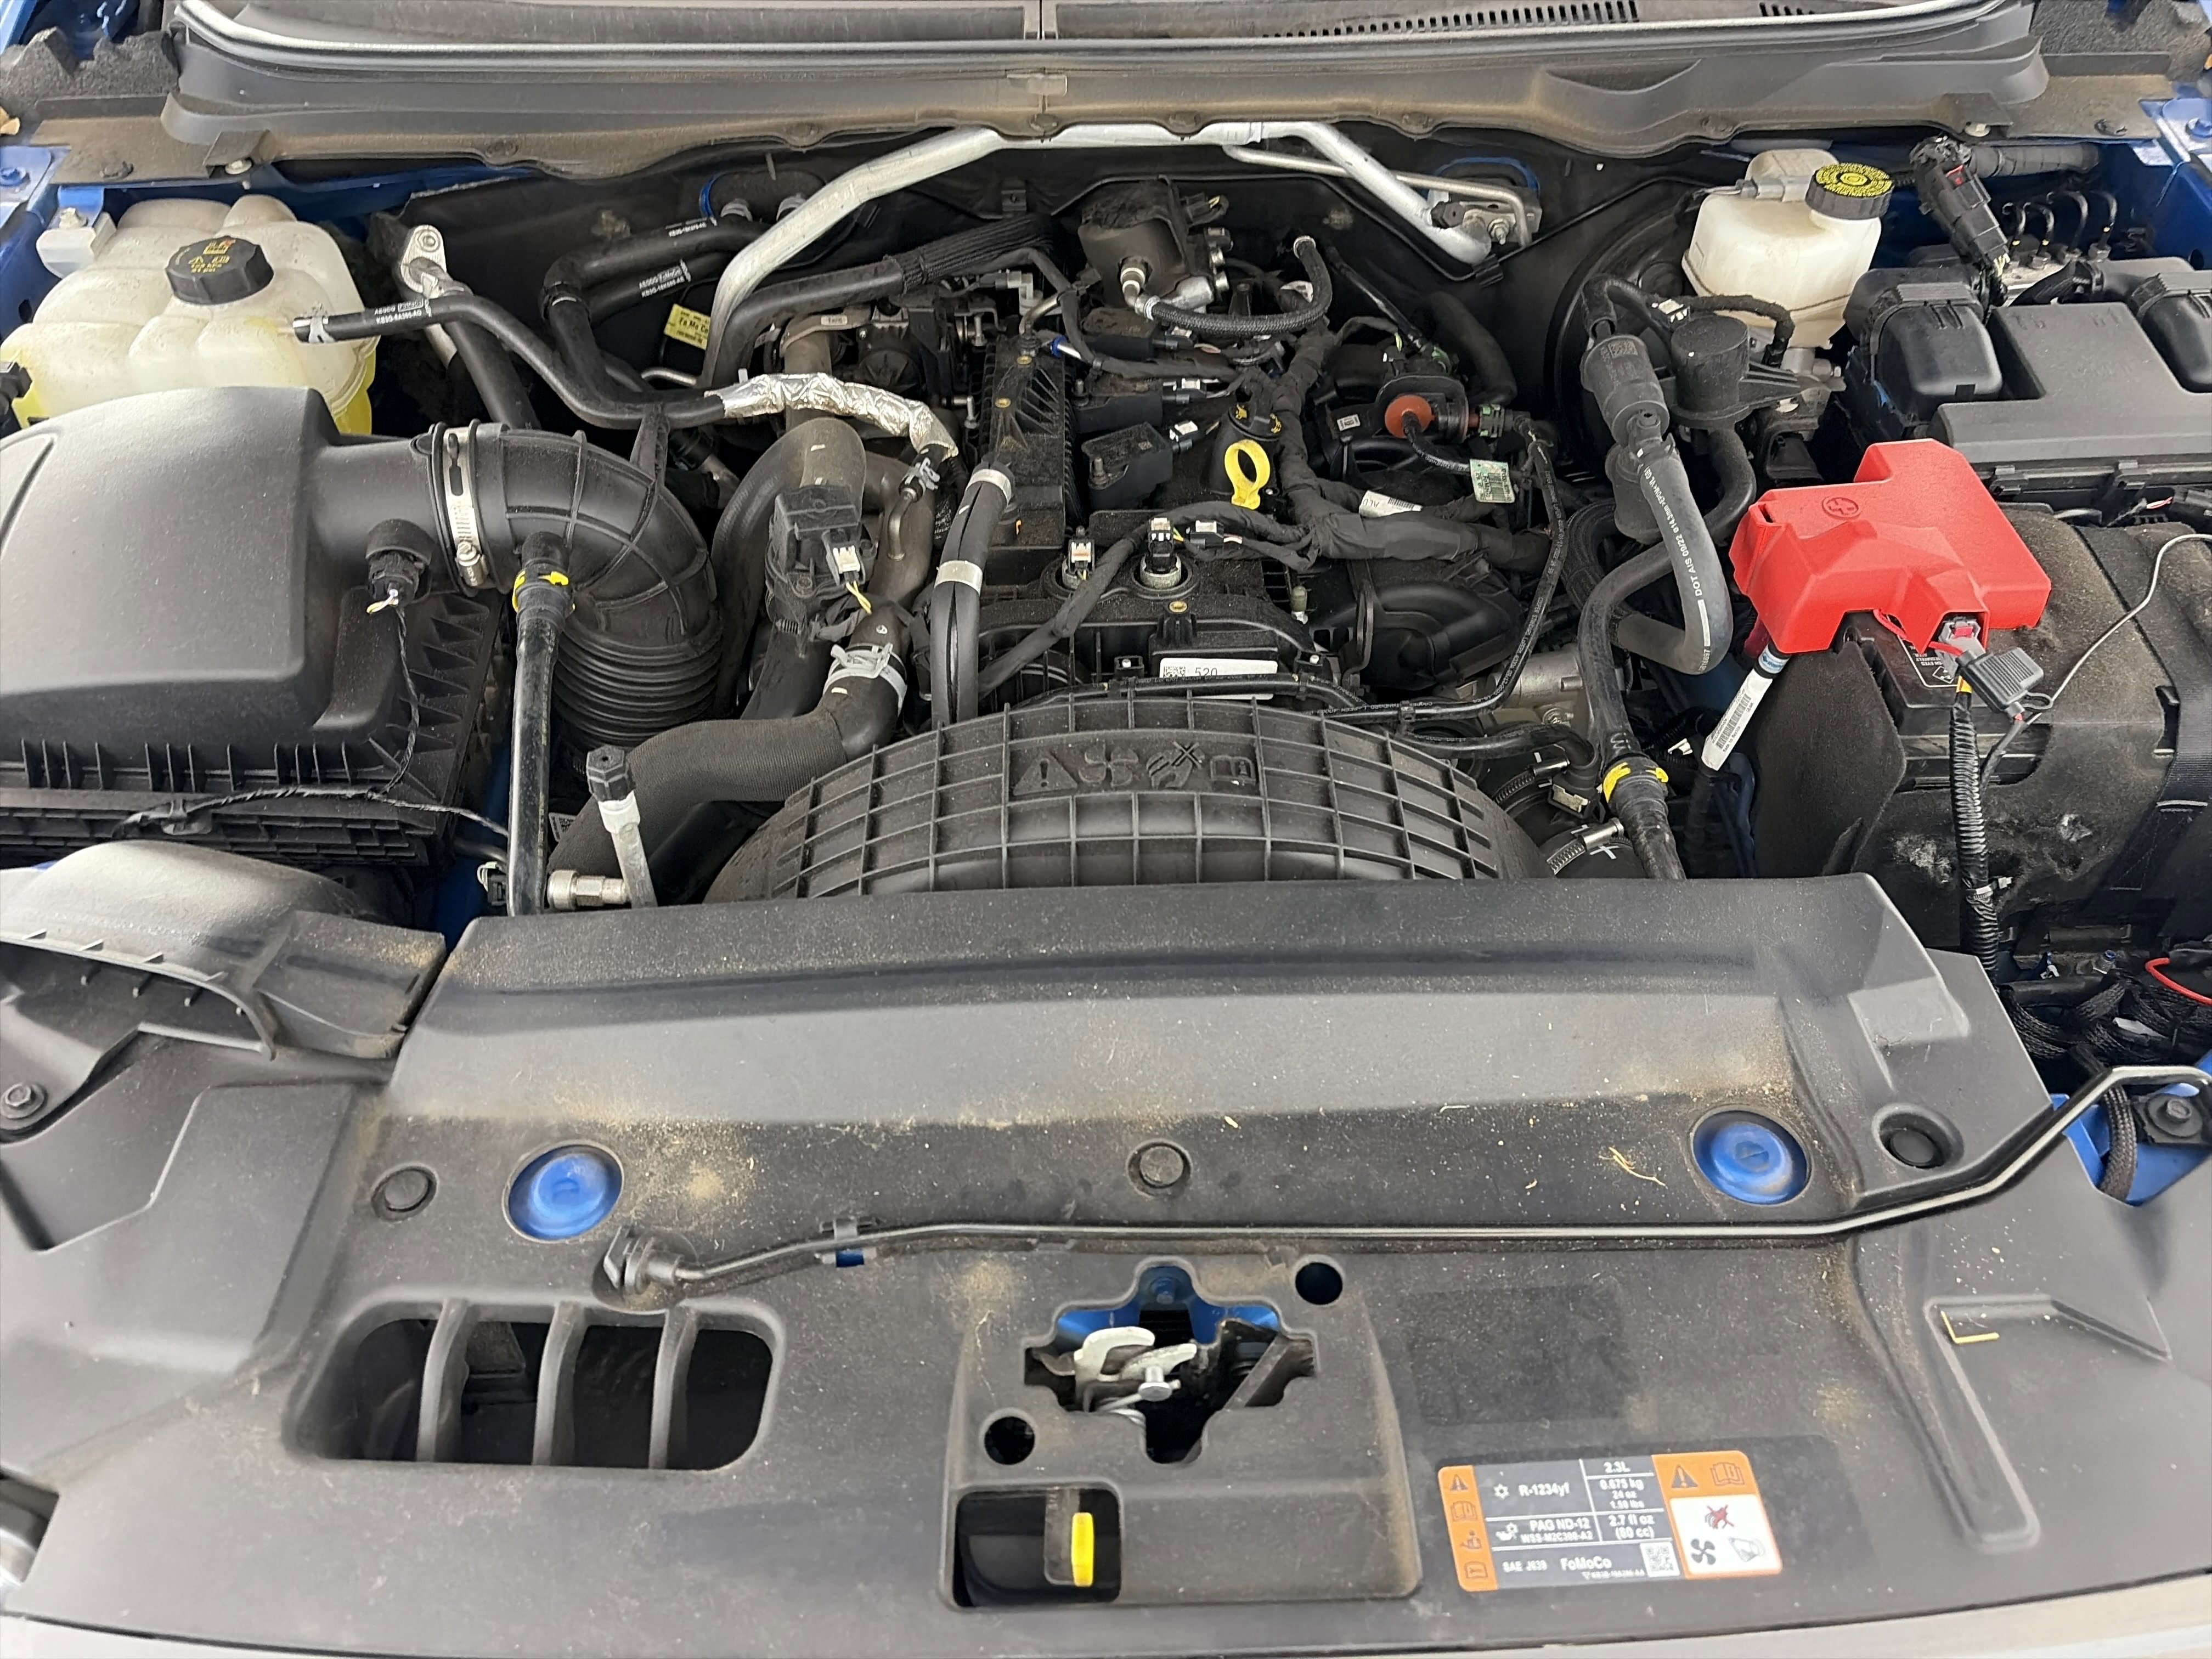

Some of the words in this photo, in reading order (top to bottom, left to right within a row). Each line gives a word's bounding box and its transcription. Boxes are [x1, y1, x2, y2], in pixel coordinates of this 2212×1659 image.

[1675, 534, 1689, 557] 09/22
[1685, 557, 1695, 574] AIS
[1690, 576, 1702, 596] DOT
[1195, 667, 1218, 676] 520
[1604, 1461, 1630, 1473] 2.3L
[1519, 1482, 1570, 1497] R-1234yf
[1600, 1479, 1628, 1490] 0.675
[1629, 1478, 1645, 1491] kg
[1612, 1491, 1624, 1499] 24
[1530, 1519, 1555, 1532] PAG
[1556, 1517, 1590, 1530] ND-12
[1609, 1514, 1626, 1527] 2.7
[1627, 1514, 1638, 1526] fl
[1639, 1515, 1656, 1525] oz
[1635, 1526, 1655, 1539] cc)
[1502, 1560, 1523, 1573] SAE
[1560, 1556, 1612, 1571] FoMoCo
